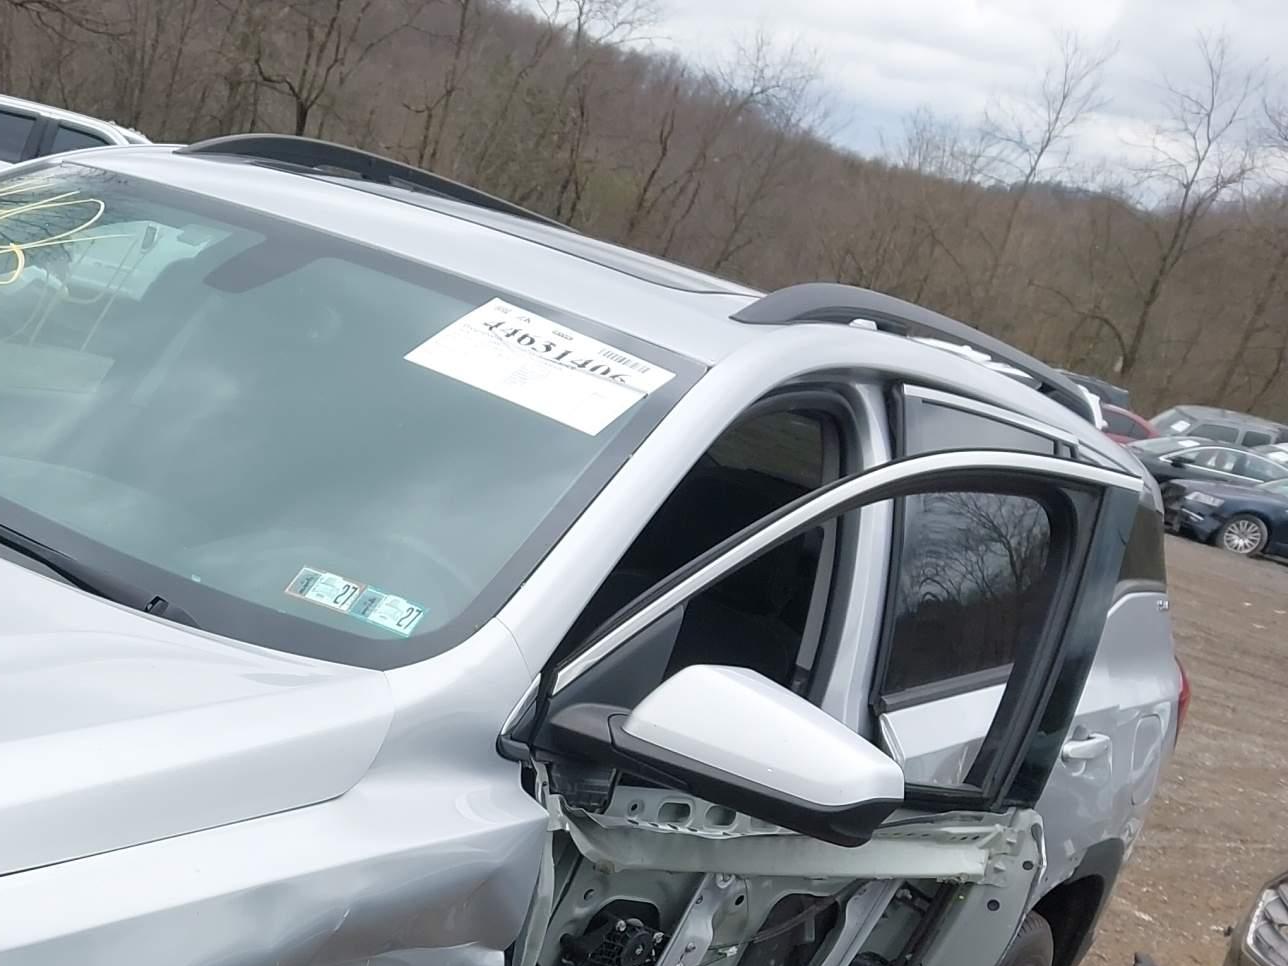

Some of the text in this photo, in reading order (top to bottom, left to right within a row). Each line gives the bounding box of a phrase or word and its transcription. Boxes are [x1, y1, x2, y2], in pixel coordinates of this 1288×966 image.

[482, 319, 630, 384] 44631406
[333, 583, 358, 607] 27
[396, 607, 423, 630] 27
